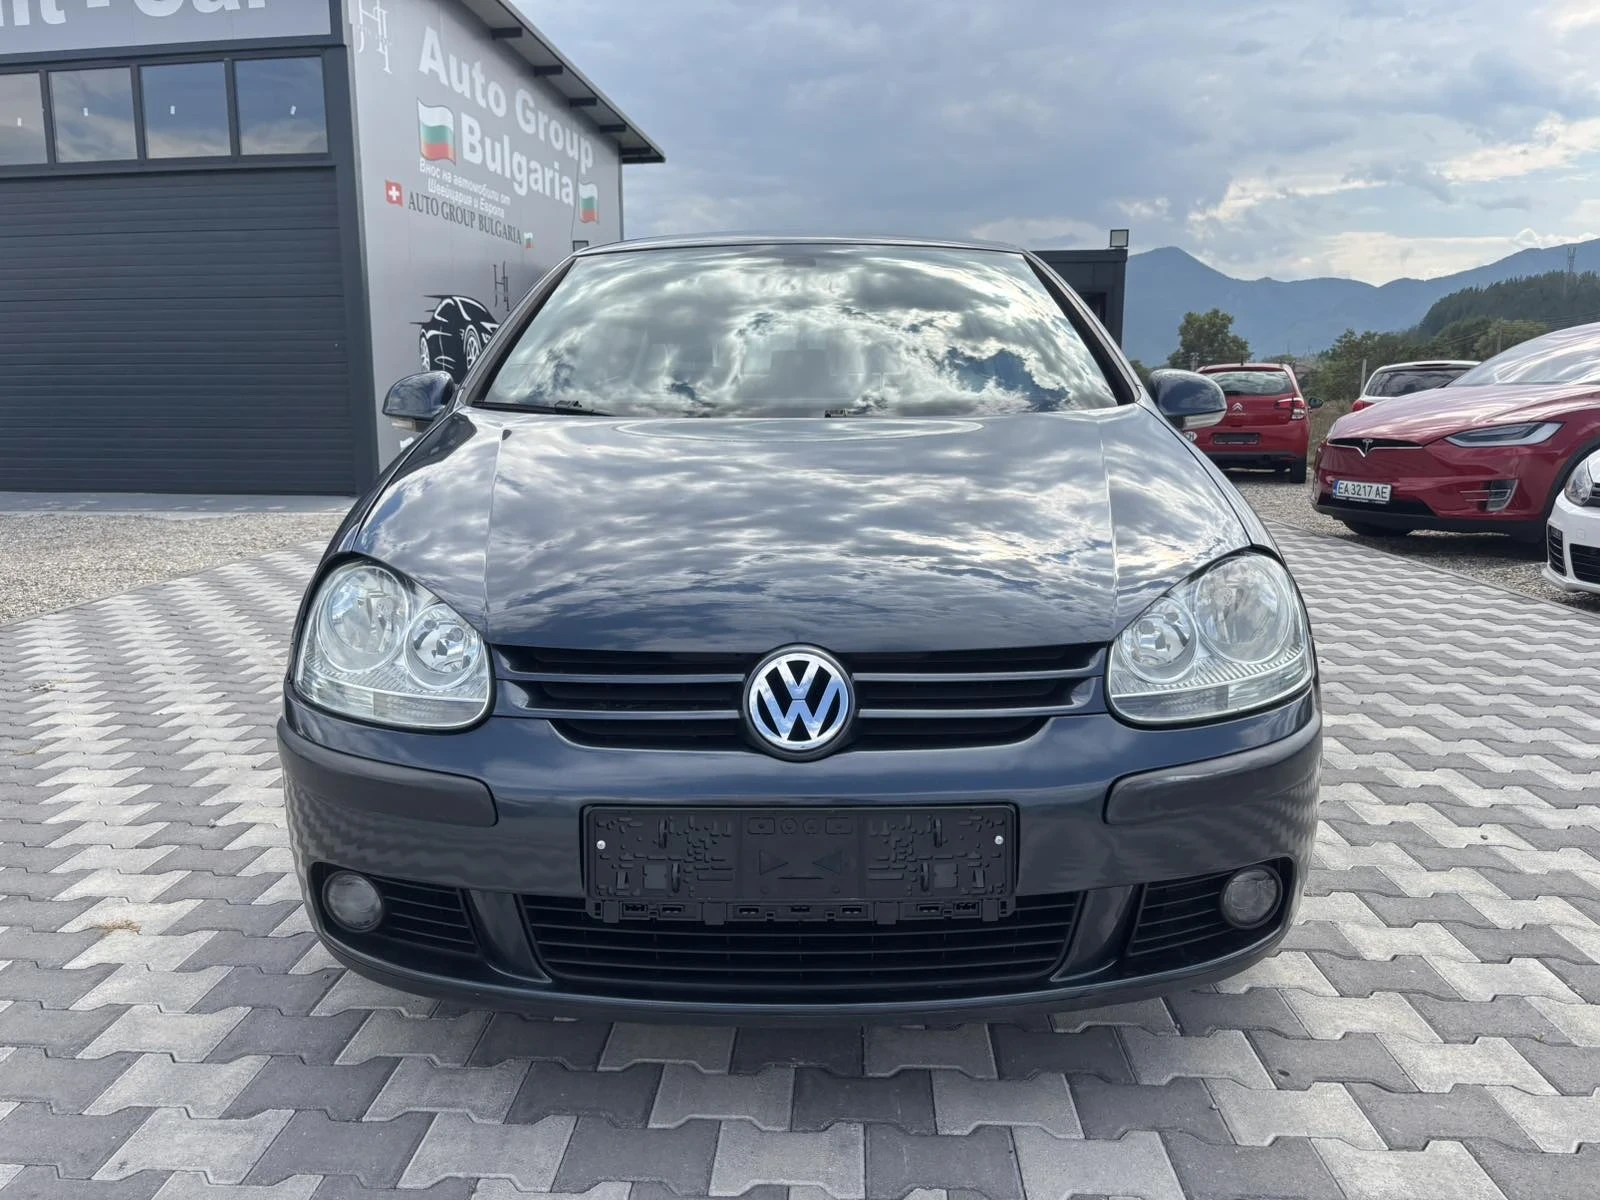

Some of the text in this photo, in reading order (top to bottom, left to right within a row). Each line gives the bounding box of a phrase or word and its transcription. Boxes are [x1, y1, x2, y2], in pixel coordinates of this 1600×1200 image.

[419, 26, 506, 117] Auto
[515, 88, 594, 175] Group
[419, 157, 441, 178] Внос
[460, 111, 575, 207] Bulgaria
[408, 191, 523, 245] AUTO GROUP BULGARIA
[1337, 481, 1389, 499] EA 3217 AE
